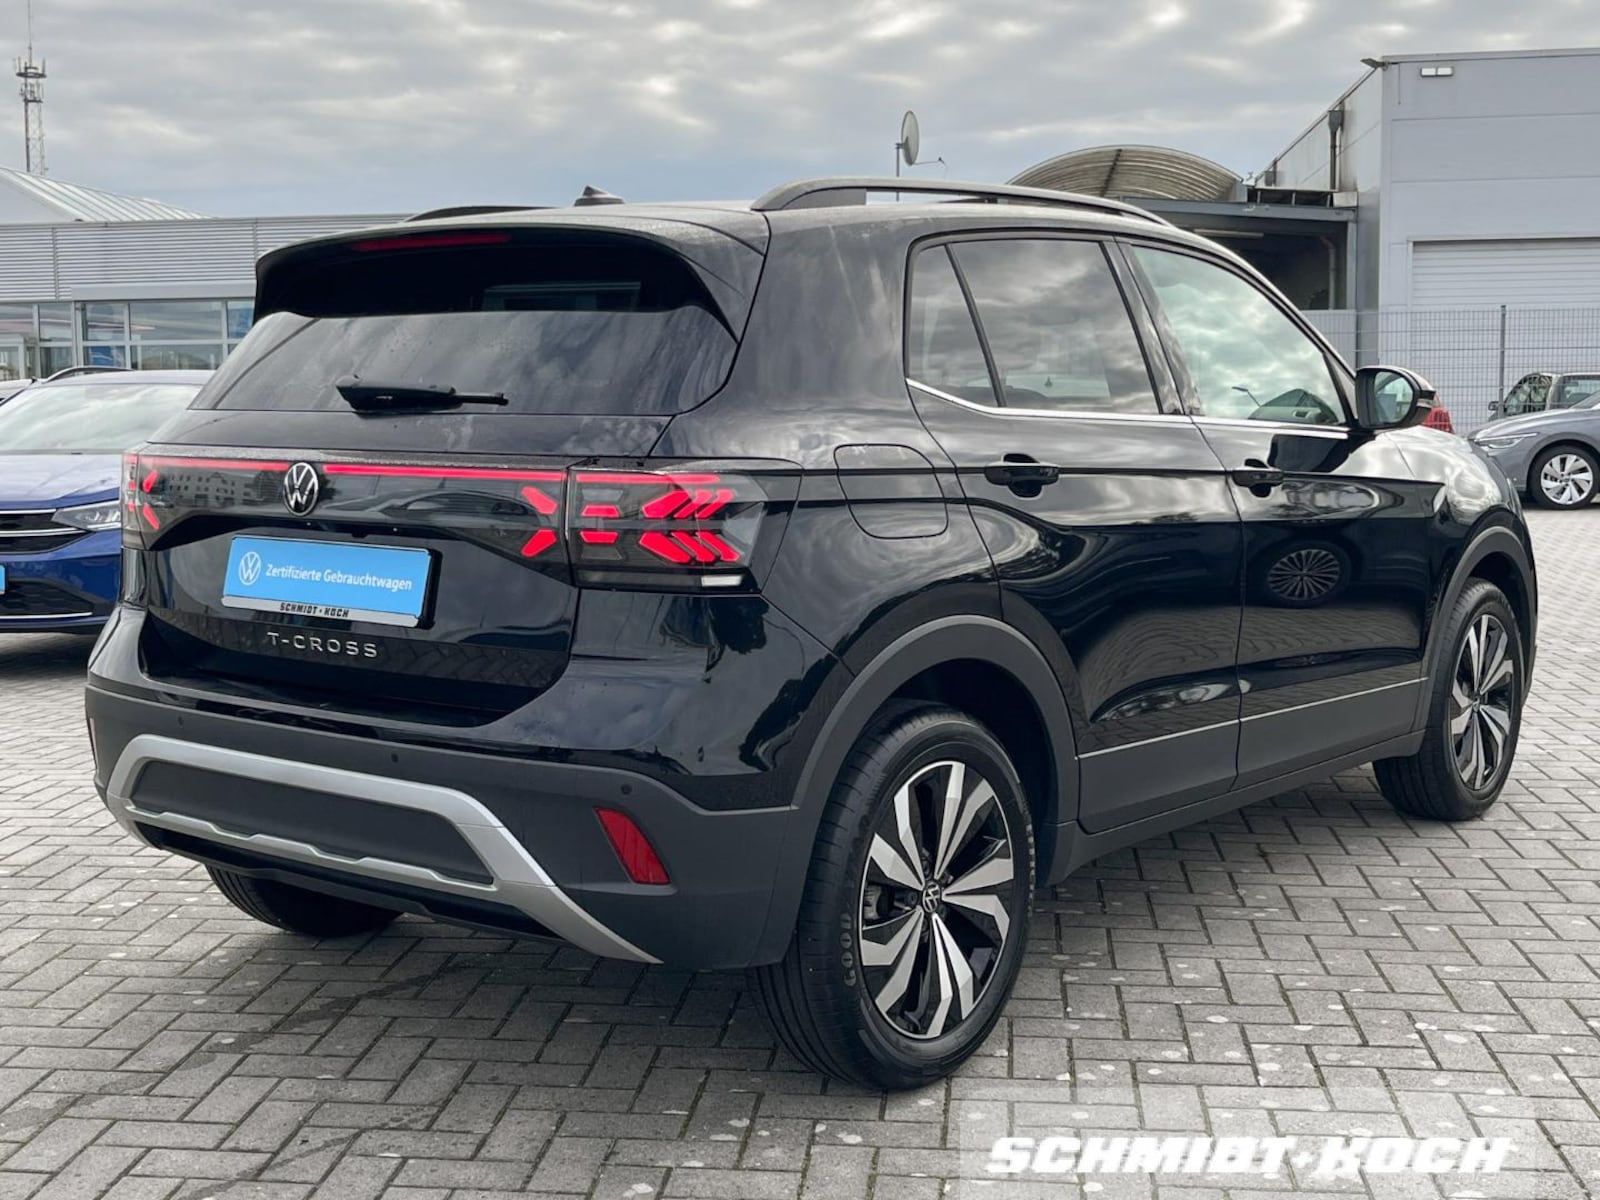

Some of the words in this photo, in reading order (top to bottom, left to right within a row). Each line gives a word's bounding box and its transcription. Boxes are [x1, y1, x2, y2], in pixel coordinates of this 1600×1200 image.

[266, 564, 321, 581] Zertifizierte
[323, 569, 412, 592] Gebrauchtwagen
[266, 632, 378, 659] T-CROSS
